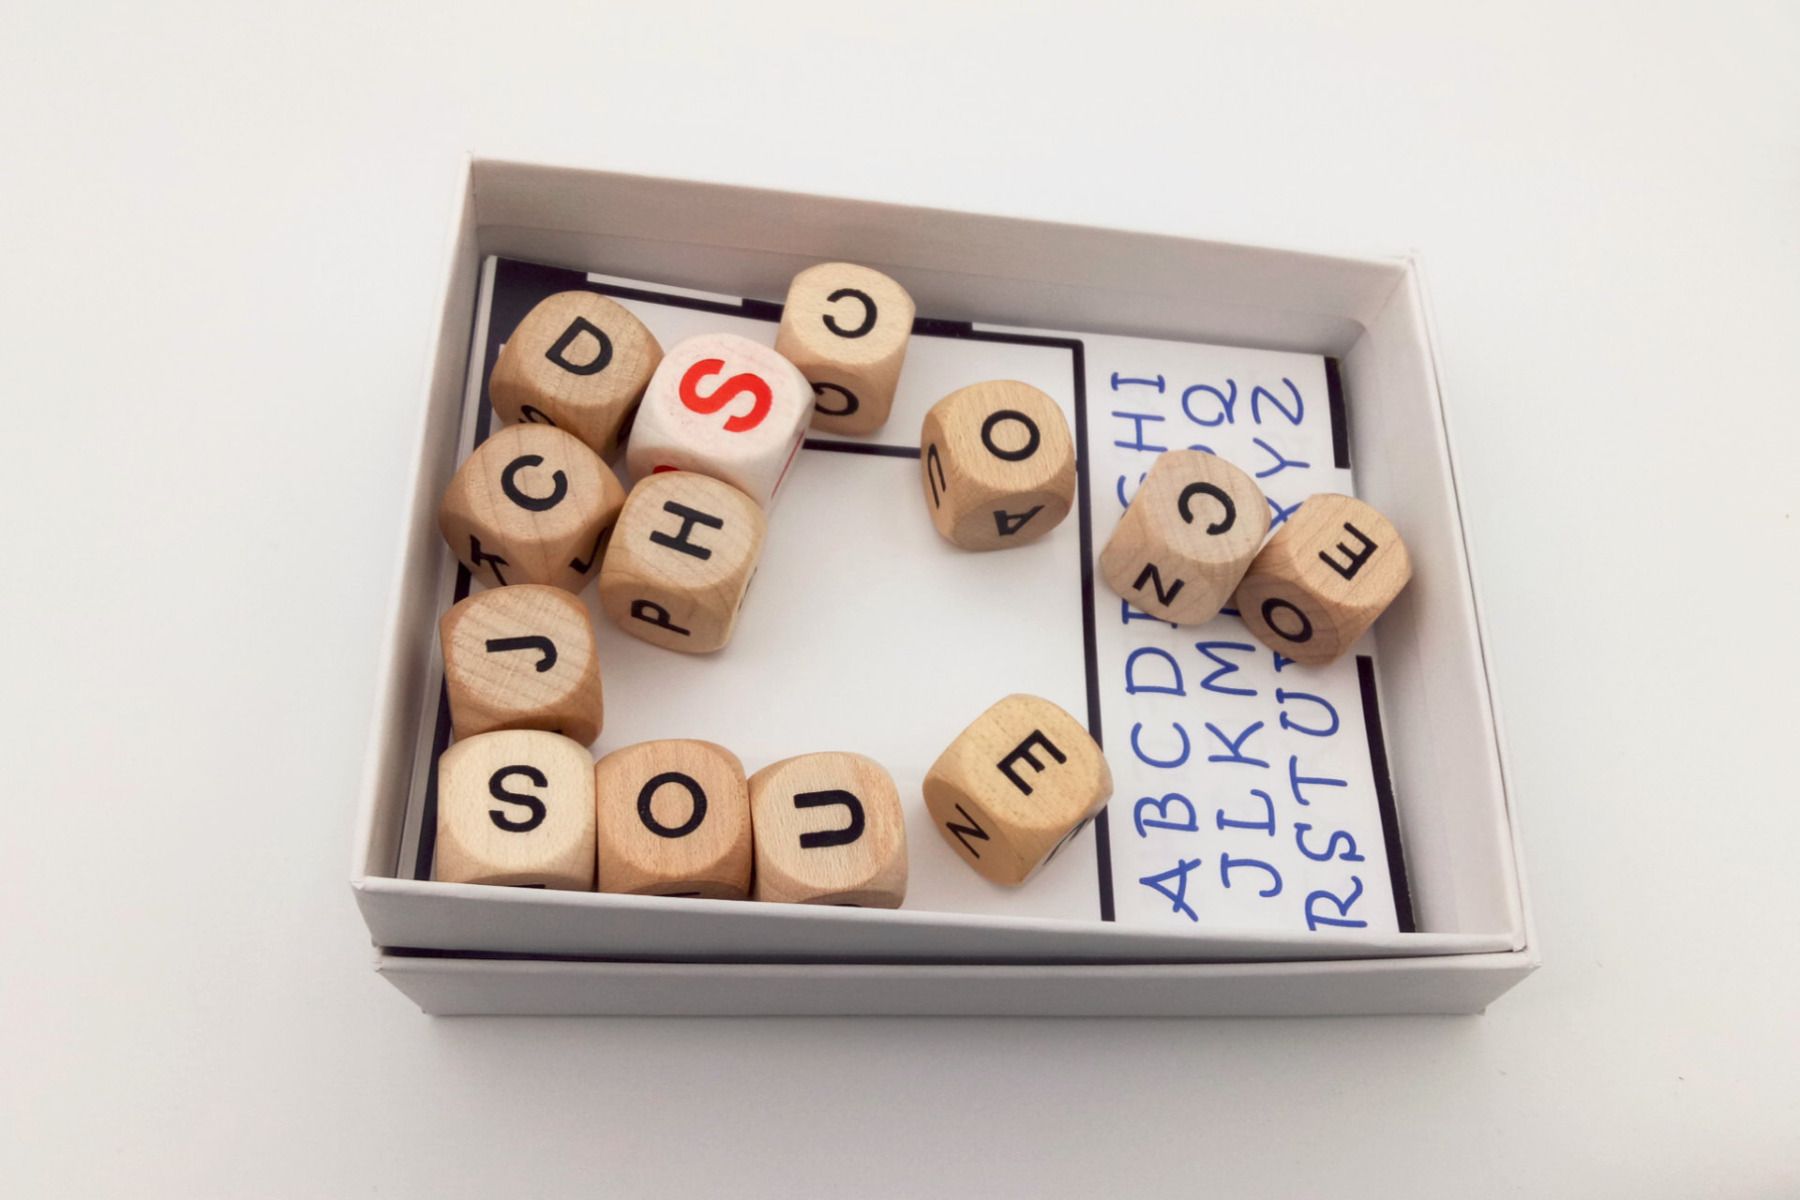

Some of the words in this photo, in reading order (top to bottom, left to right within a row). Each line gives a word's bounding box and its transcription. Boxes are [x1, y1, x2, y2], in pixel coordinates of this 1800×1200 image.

[822, 288, 877, 339] C
[545, 316, 613, 376] D
[678, 358, 774, 433] S
[981, 410, 1040, 462] O
[501, 454, 568, 512] C
[1177, 482, 1236, 536] C
[649, 501, 724, 561] H
[992, 504, 1045, 537] A
[1318, 522, 1378, 581] E
[1259, 596, 1315, 645] O
[485, 635, 558, 673] J
[996, 729, 1067, 796] E
[488, 765, 548, 833] S
[636, 771, 708, 839] O
[793, 789, 865, 849] U
